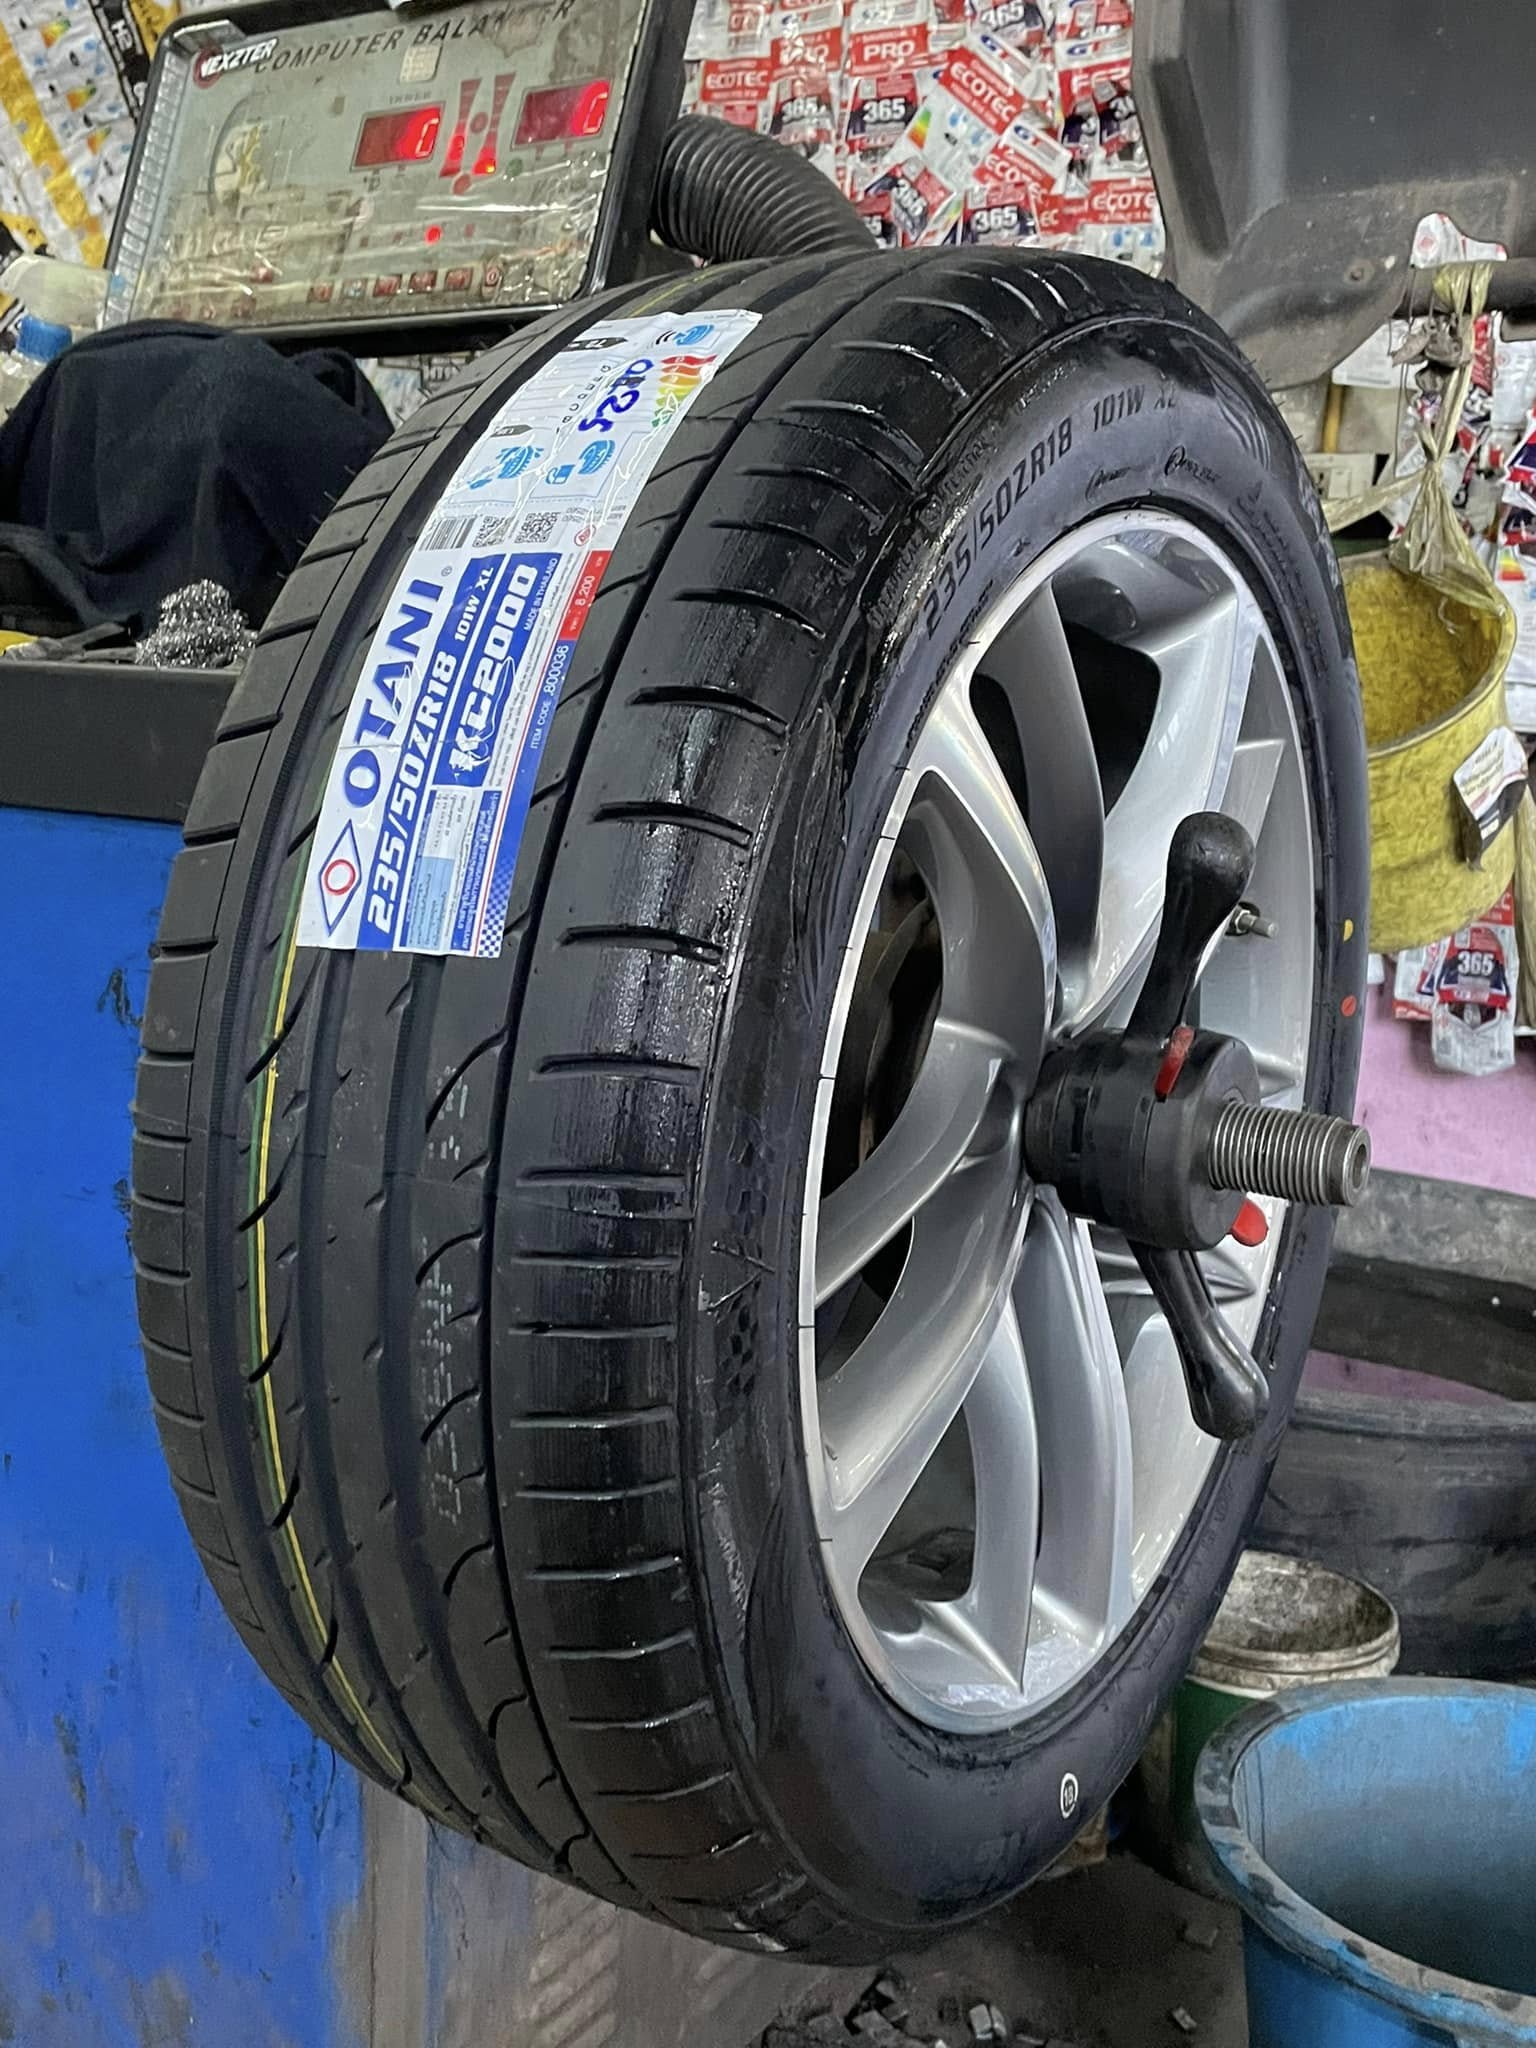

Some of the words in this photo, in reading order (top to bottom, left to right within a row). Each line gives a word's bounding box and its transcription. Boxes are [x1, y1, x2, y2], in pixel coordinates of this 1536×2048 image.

[201, 38, 279, 78] NEXZTER
[254, 28, 404, 74] COMPUTER
[412, 0, 574, 47] BALANR
[864, 41, 915, 62] PRO
[706, 70, 768, 90] ECOTEC
[950, 62, 1017, 121] ECOTEC
[863, 98, 906, 123] 365
[974, 207, 1019, 234] 365
[925, 417, 1073, 640] 235/50ZR18
[1092, 385, 1146, 432] 101W
[524, 607, 538, 631] MADE
[448, 563, 538, 772] KC2000
[343, 578, 446, 808] OTANI
[531, 727, 543, 749] ITEM
[537, 700, 552, 726] CODE
[368, 650, 457, 936] 235/50ZR18
[453, 594, 480, 643] 101W
[476, 566, 494, 590] XL
[1457, 951, 1495, 976] 365
